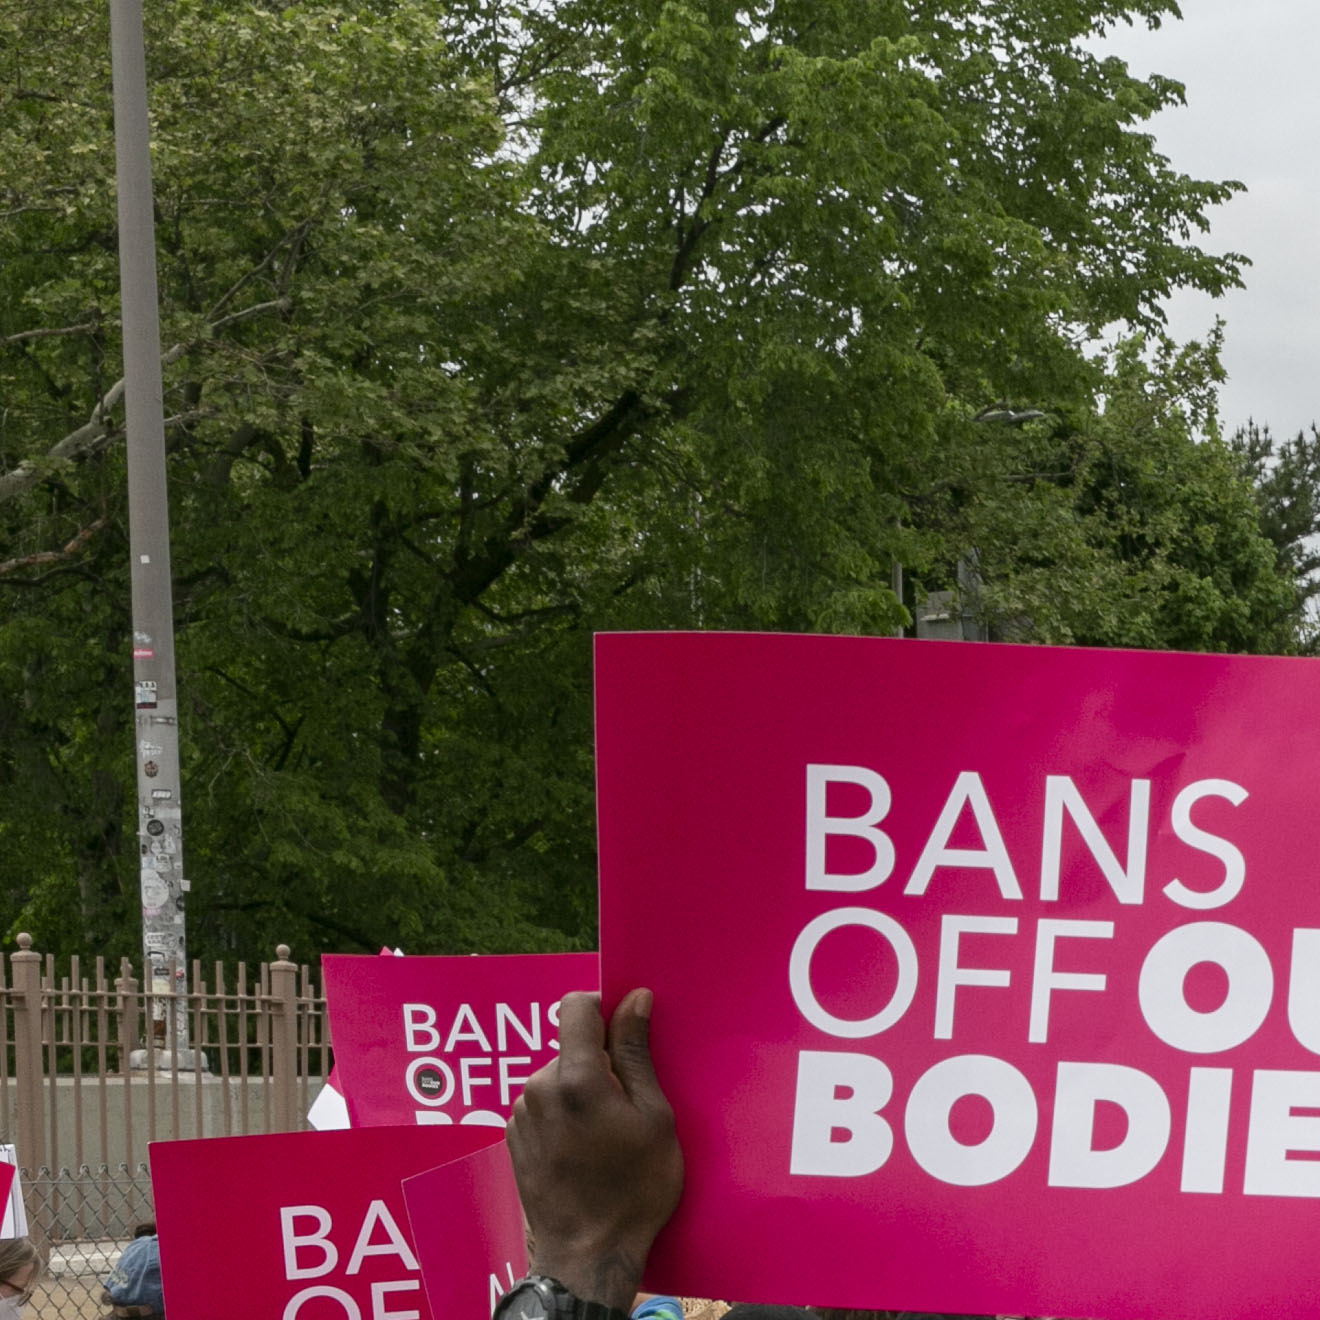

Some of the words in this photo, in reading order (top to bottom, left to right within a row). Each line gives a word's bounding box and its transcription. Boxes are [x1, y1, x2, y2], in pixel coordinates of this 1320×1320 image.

[804, 763, 1250, 911] BANS
[788, 906, 1115, 1045] OFF
[405, 1056, 532, 1107] OFF
